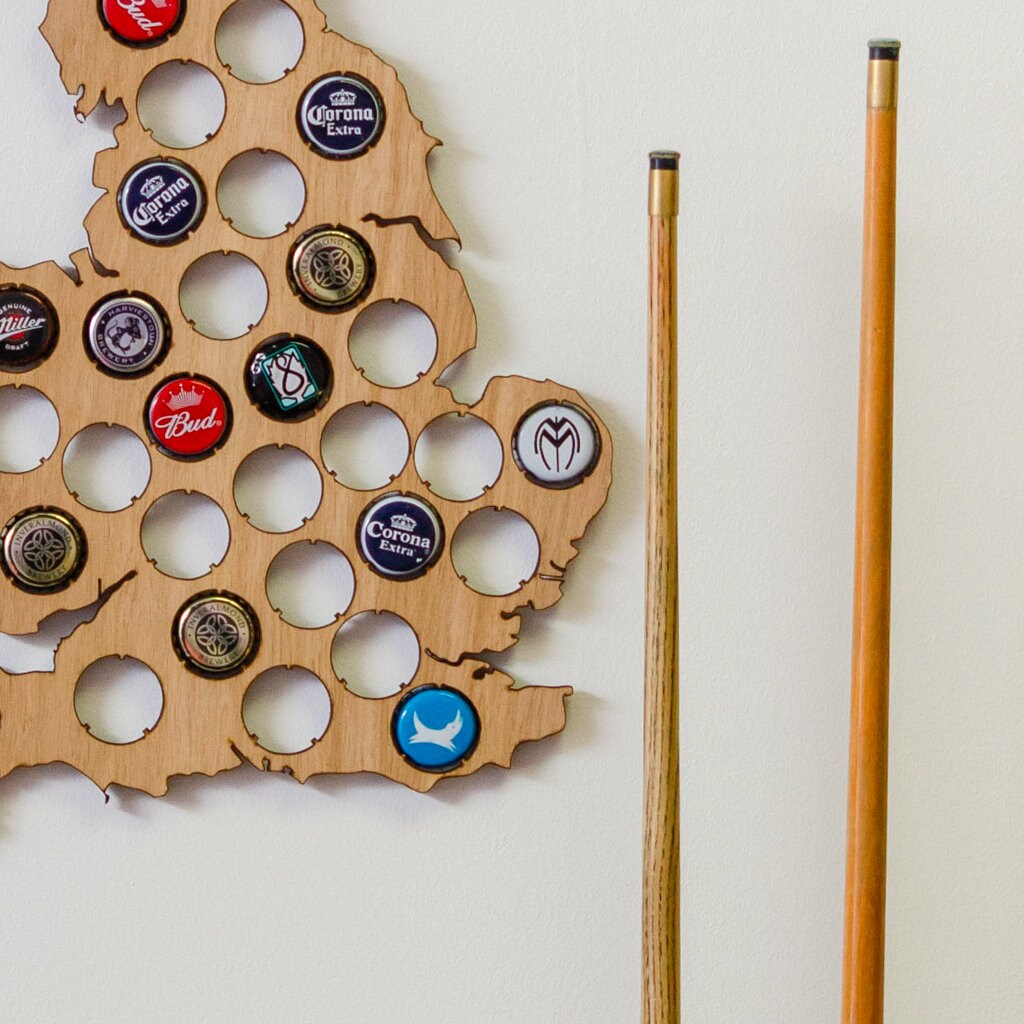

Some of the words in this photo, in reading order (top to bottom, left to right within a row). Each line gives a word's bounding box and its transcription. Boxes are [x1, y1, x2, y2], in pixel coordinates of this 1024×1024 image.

[307, 104, 374, 127] Corona
[327, 122, 362, 136] Extra
[132, 177, 190, 226] Corona
[155, 199, 190, 225] Extra
[4, 341, 30, 351] DRAFT
[97, 333, 134, 364] BREWERY
[155, 407, 218, 439] Bud
[367, 520, 431, 549] Corona
[379, 540, 414, 556] Extra
